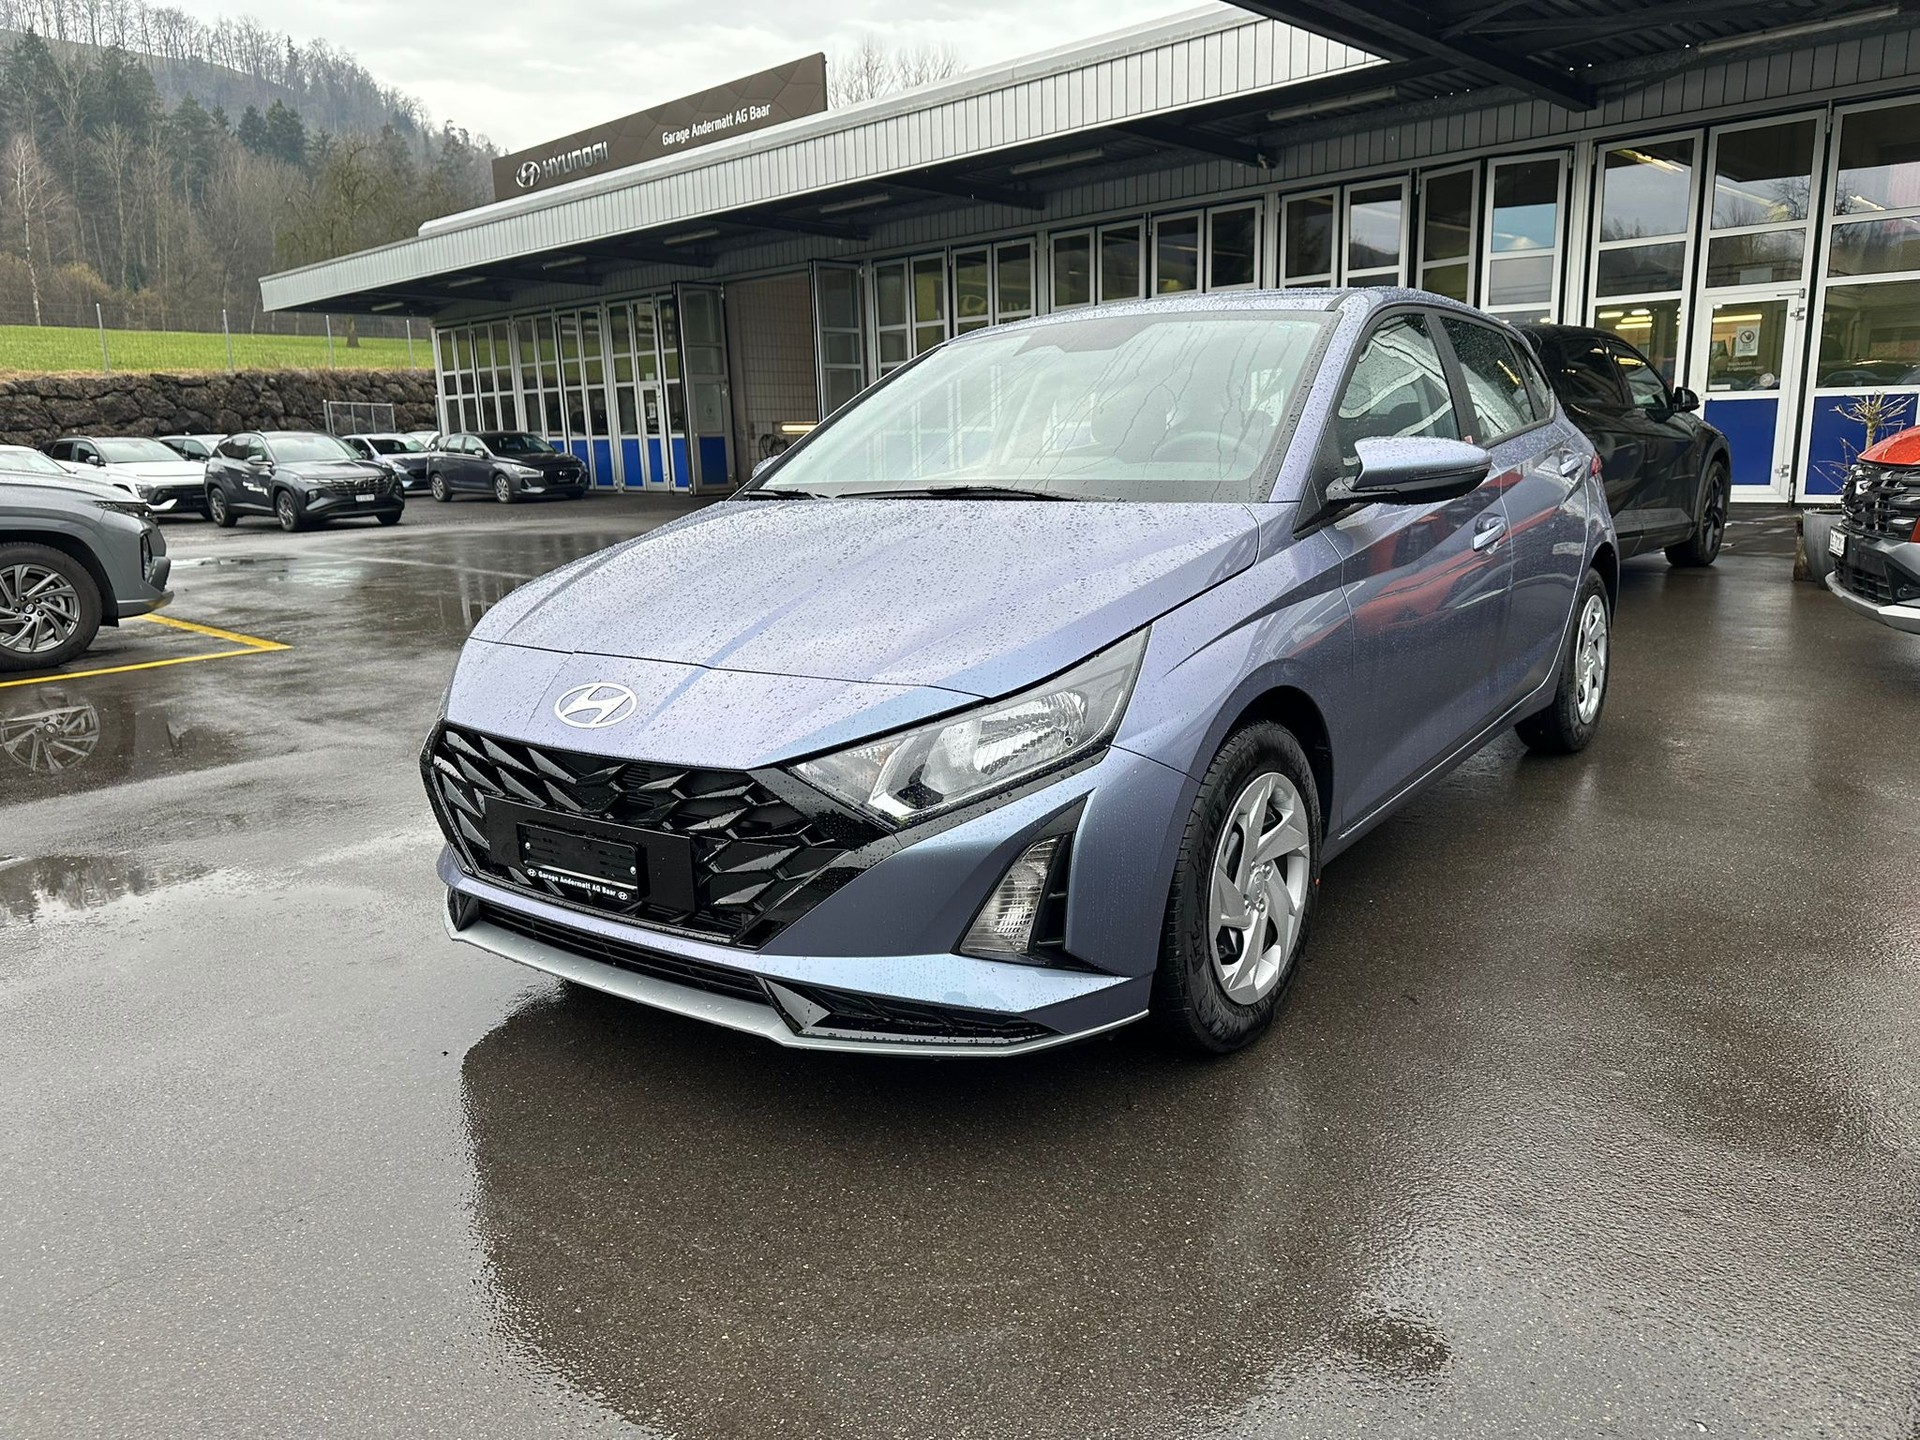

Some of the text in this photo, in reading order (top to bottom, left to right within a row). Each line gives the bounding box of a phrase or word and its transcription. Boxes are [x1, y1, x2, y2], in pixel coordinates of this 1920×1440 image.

[662, 104, 771, 146] Garage Andermatt AG Baar
[542, 141, 609, 178] HYUNDAI
[538, 870, 617, 896] Garage Andermatt AG Baar
